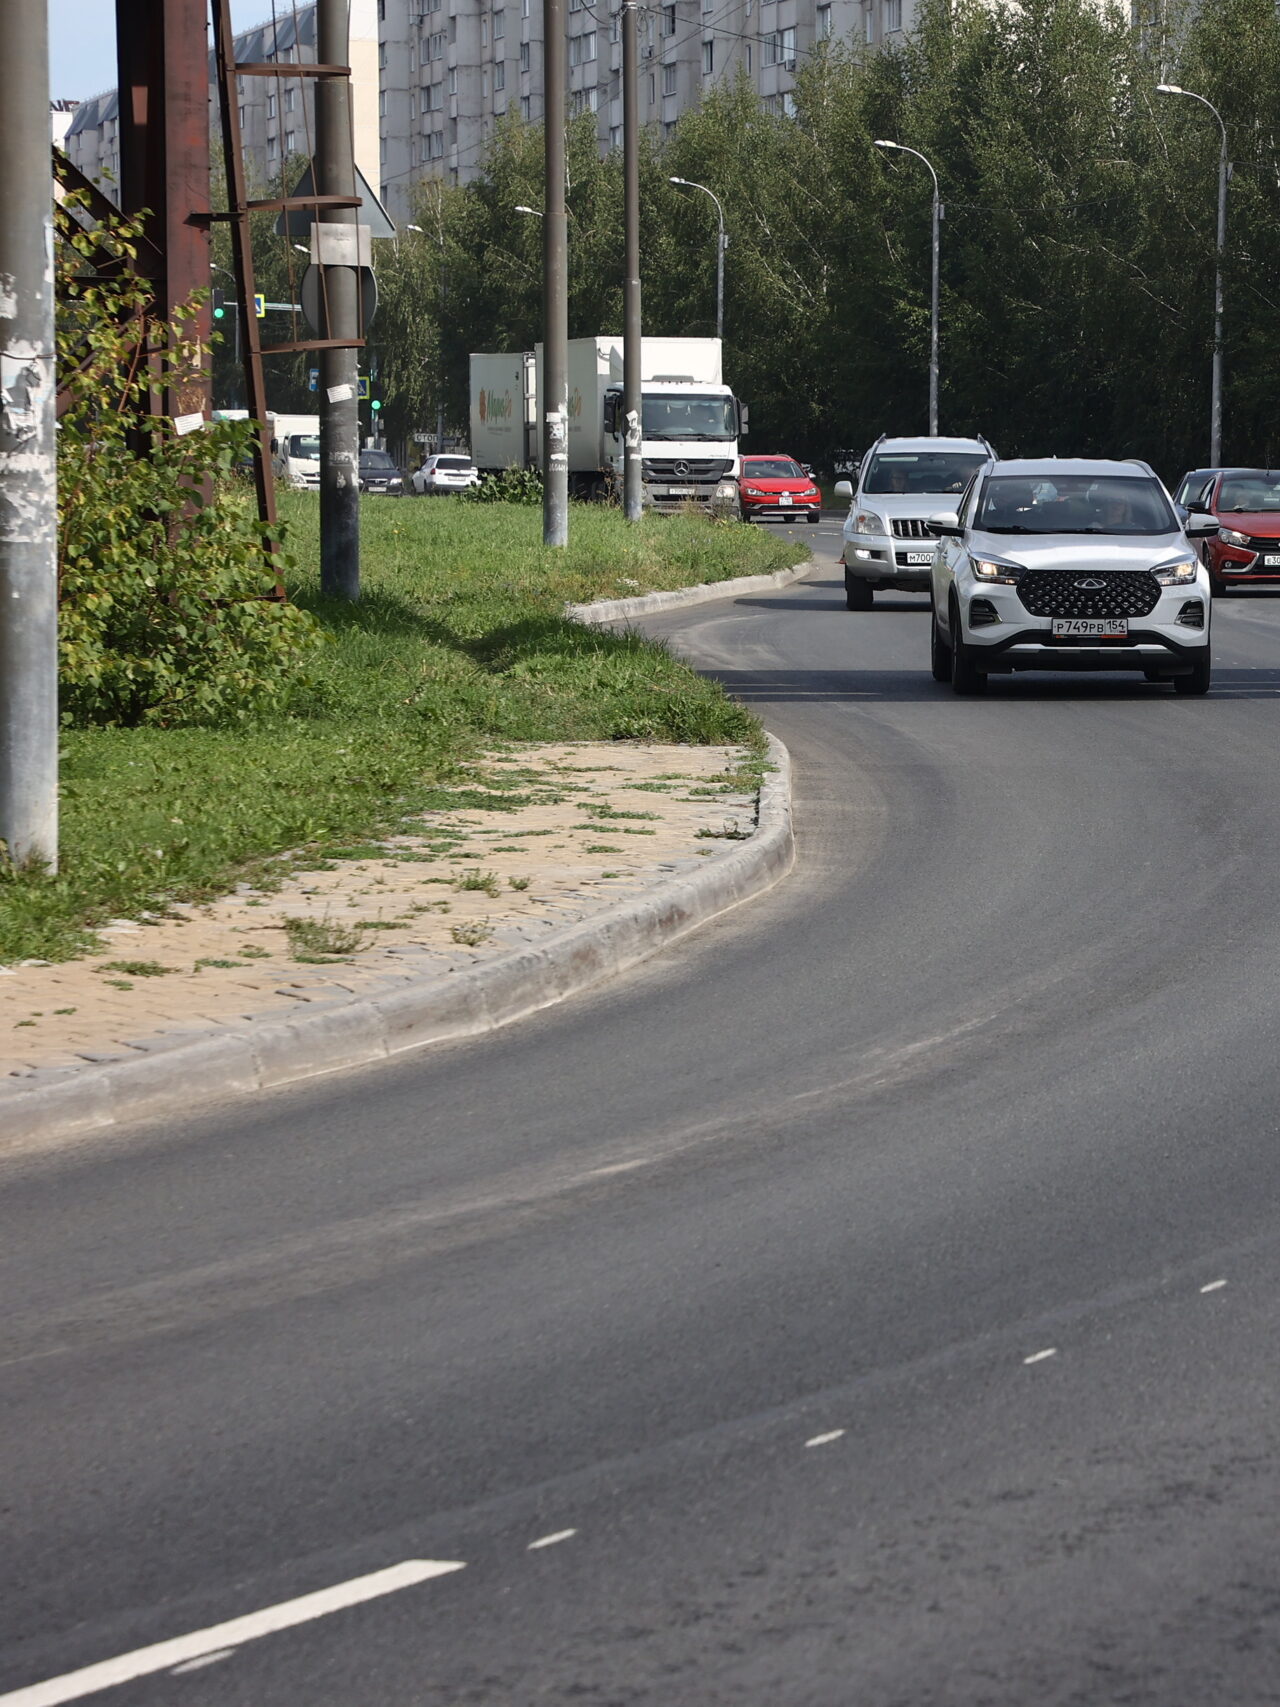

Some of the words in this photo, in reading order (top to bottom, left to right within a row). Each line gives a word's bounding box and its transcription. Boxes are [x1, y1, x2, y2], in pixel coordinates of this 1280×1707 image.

[416, 434, 438, 442] СТОП
[909, 553, 933, 562] М700
[1057, 620, 1104, 633] Р749РВ
[1106, 620, 1126, 630] 154
